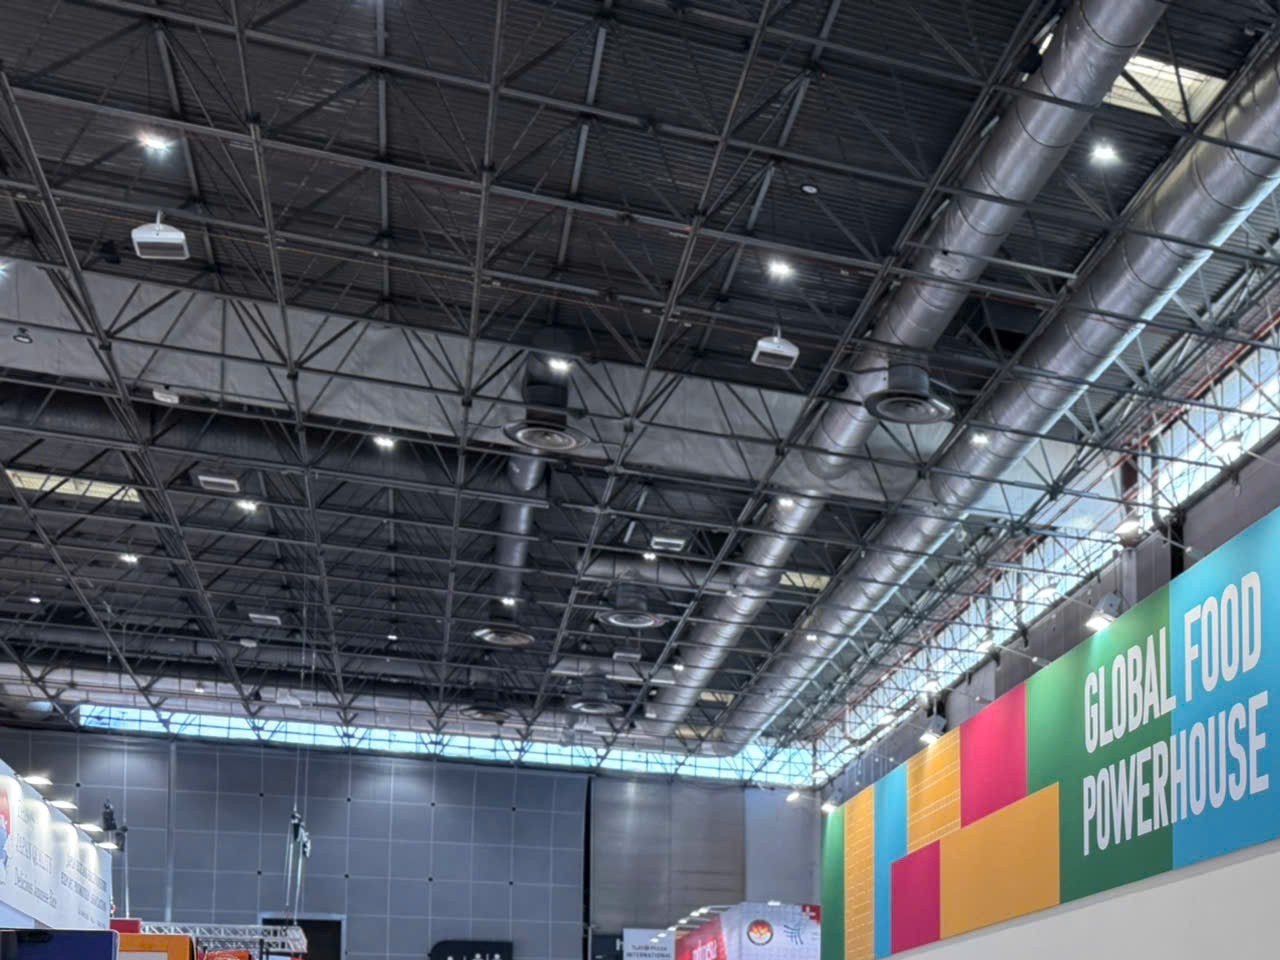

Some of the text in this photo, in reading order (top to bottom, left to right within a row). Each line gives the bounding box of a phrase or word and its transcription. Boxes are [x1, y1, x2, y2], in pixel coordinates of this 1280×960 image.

[1083, 571, 1262, 753] GLOBAL FOOD
[1083, 691, 1269, 856] POWERHOUSE
